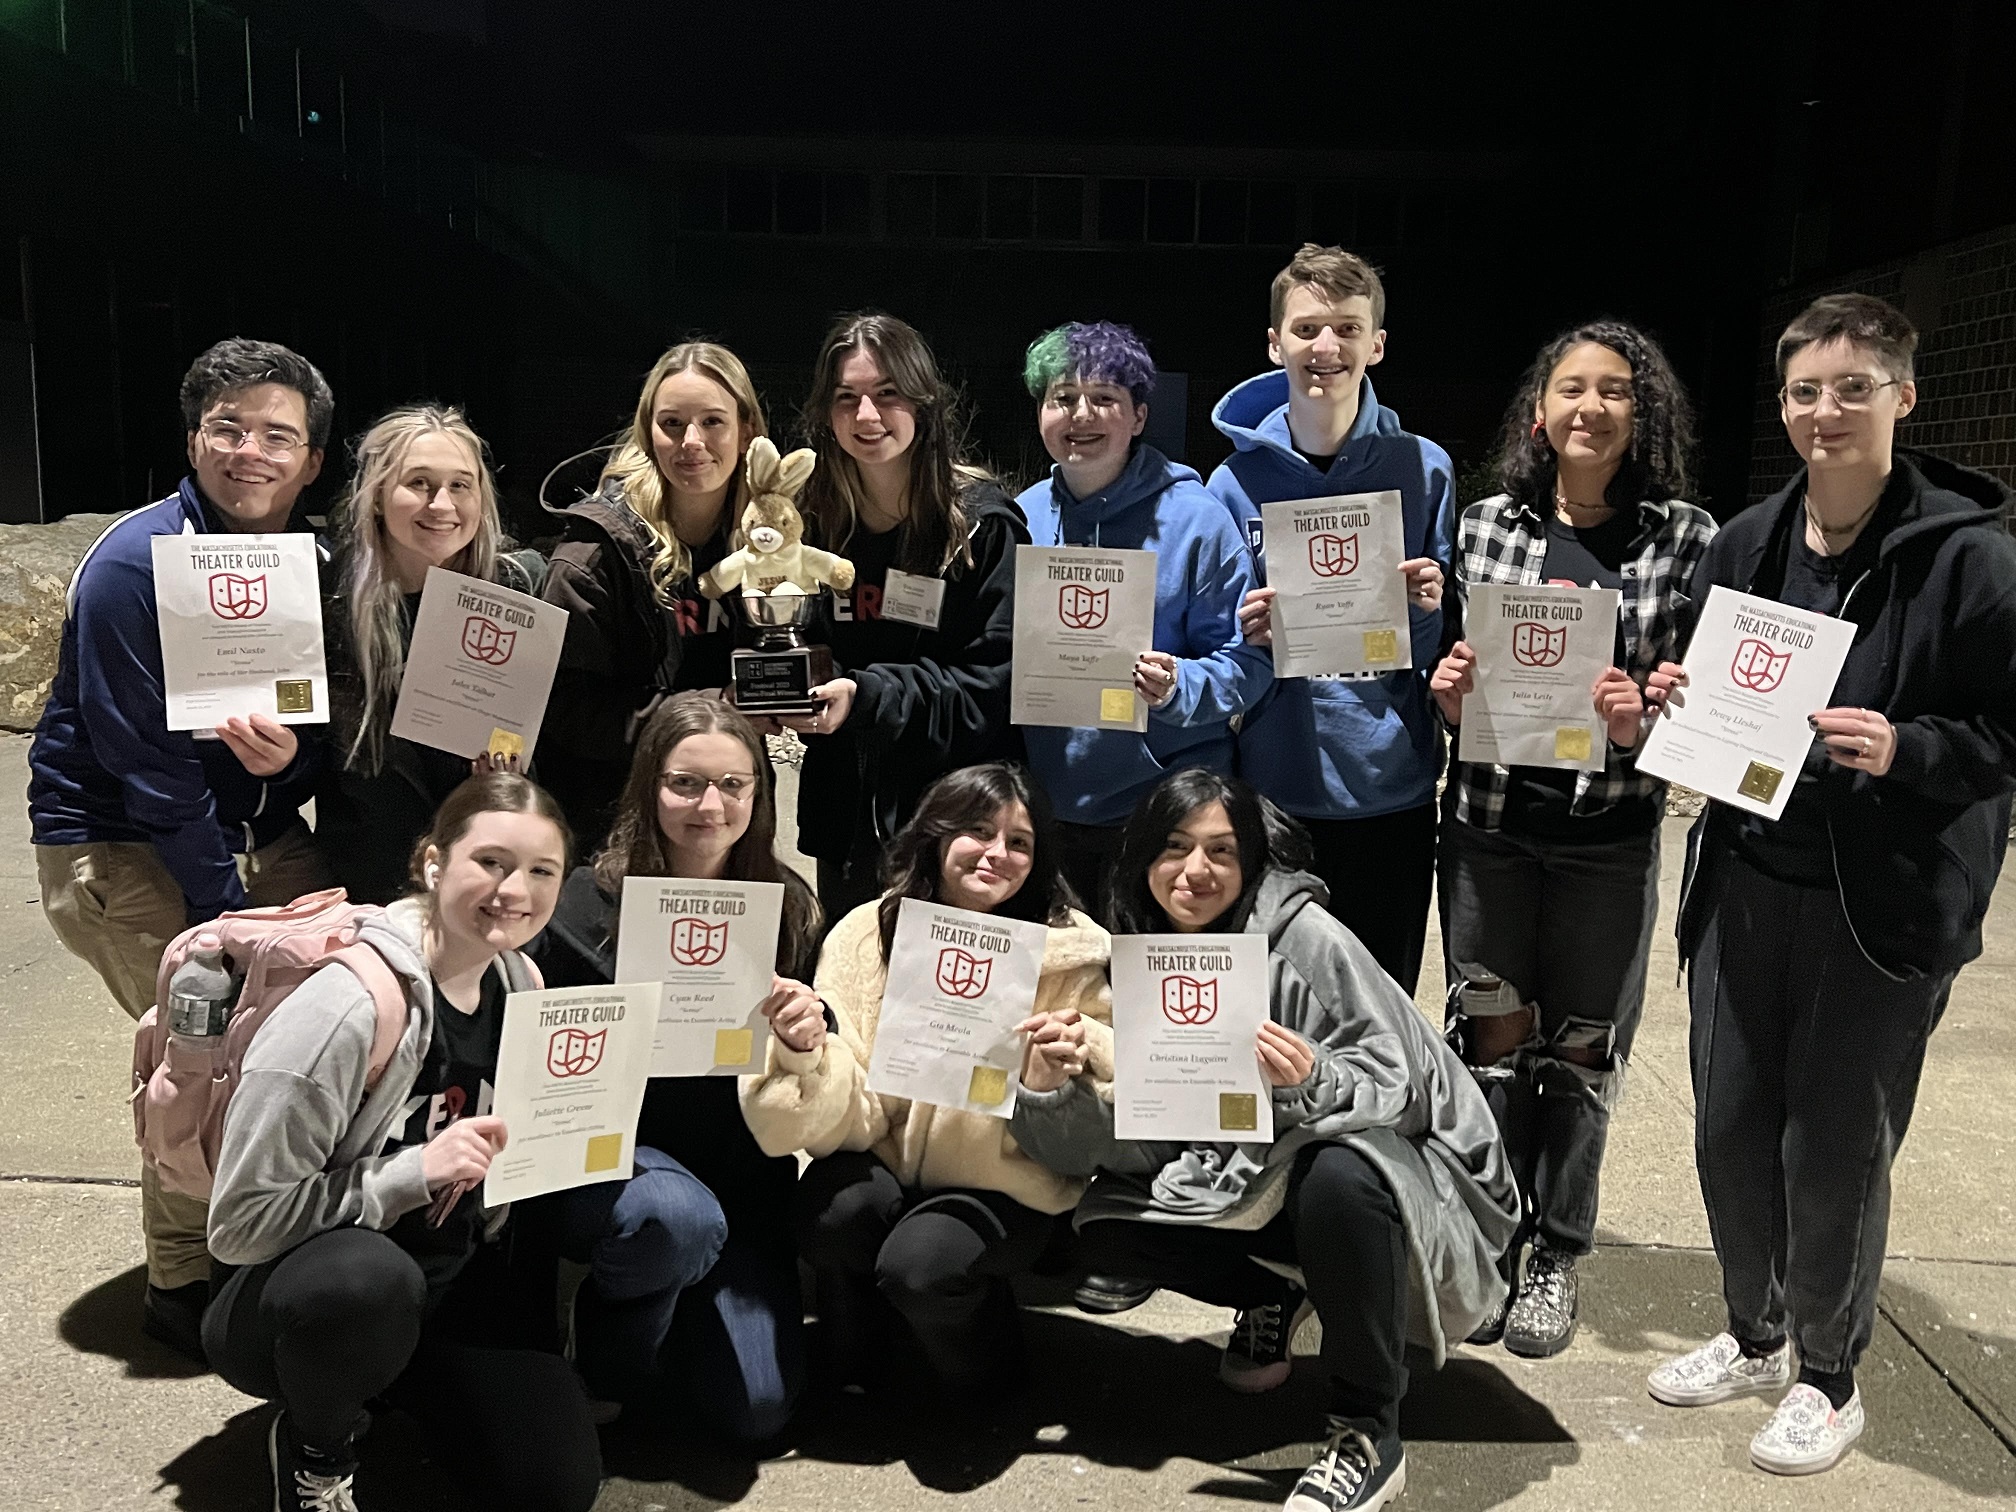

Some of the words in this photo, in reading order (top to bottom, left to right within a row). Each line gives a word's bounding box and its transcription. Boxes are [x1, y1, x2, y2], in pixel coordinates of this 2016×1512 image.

[1294, 516, 1338, 533] THEATER
[1341, 513, 1371, 529] GUILD
[190, 554, 243, 569] THEATER
[247, 553, 280, 568] GUILD
[1048, 565, 1092, 582] THEATER
[1095, 568, 1124, 583] GUILD
[456, 593, 503, 619] THEATER
[505, 608, 535, 629] GUILD
[1502, 603, 1548, 619] THEATER
[1551, 606, 1583, 621] GUILD
[1740, 604, 1749, 612] THE
[1733, 613, 1780, 640] THEATER
[1781, 628, 1814, 649] GUILD
[217, 647, 237, 656] Emil
[240, 647, 266, 655] Nasto
[1512, 691, 1532, 699] Julia
[1709, 708, 1732, 724] Dewy
[659, 898, 709, 914] THEATER
[713, 901, 746, 916] GUILD
[931, 923, 977, 948] THEATER
[980, 934, 1011, 954] GUILD
[1146, 955, 1197, 972] THEATER
[1200, 955, 1233, 972] GUILD
[670, 994, 691, 1004] Cyan
[694, 994, 715, 1002] Reed
[539, 1007, 590, 1027] THEATER
[592, 1005, 626, 1022] GUILD
[1149, 1053, 1188, 1063] Christina
[533, 1106, 565, 1120] Juliette
